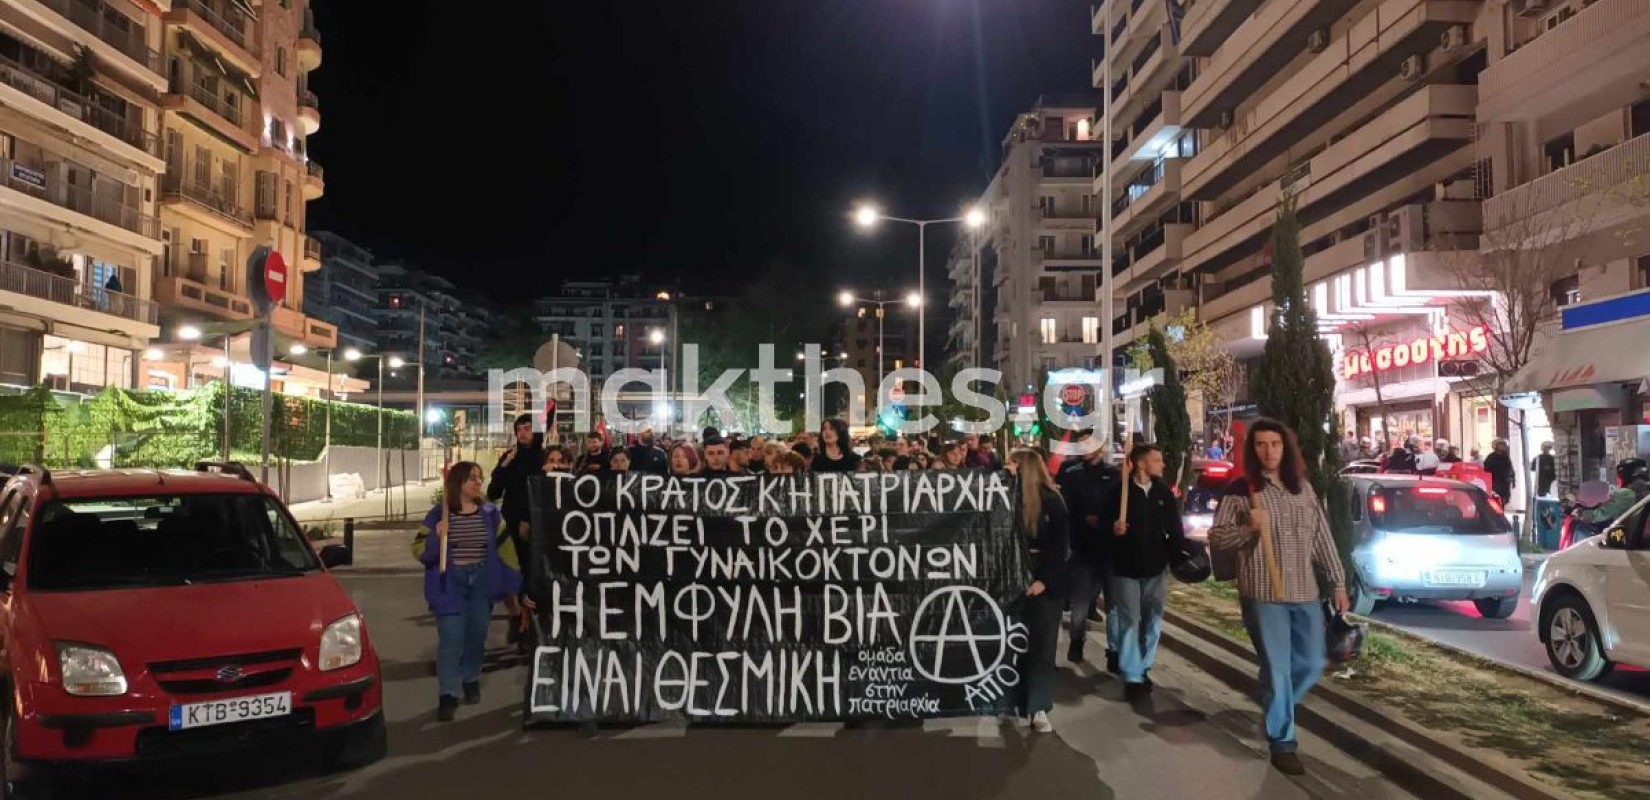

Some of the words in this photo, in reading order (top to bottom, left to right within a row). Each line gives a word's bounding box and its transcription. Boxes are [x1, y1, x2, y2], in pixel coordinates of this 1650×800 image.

[1064, 388, 1085, 403] STOP
[547, 472, 600, 510] ΤΟ
[616, 473, 756, 513] ΚΡΑΤΟΣ
[817, 472, 1011, 513] ΠΑΤΡΙΑΡΧΙΑ
[562, 510, 705, 547] ΟΠΛΙΖΕΙ
[734, 515, 788, 547] ΤΟ
[806, 514, 889, 546] ΧΕΡΙ
[558, 545, 640, 578] ΤΩΝ
[666, 543, 977, 581] ΓΥΝΑΙΚΟΚΤΟΝΩΝ
[552, 580, 584, 639] Η
[599, 580, 802, 644] ΕΜΦΥΛΗ
[824, 582, 903, 645] ΒΙΑ
[531, 645, 642, 715] ΕΙΝΑΙ
[653, 648, 841, 716] ΘΕΣΜΙΚΗ
[848, 692, 940, 720] πατριαρχία
